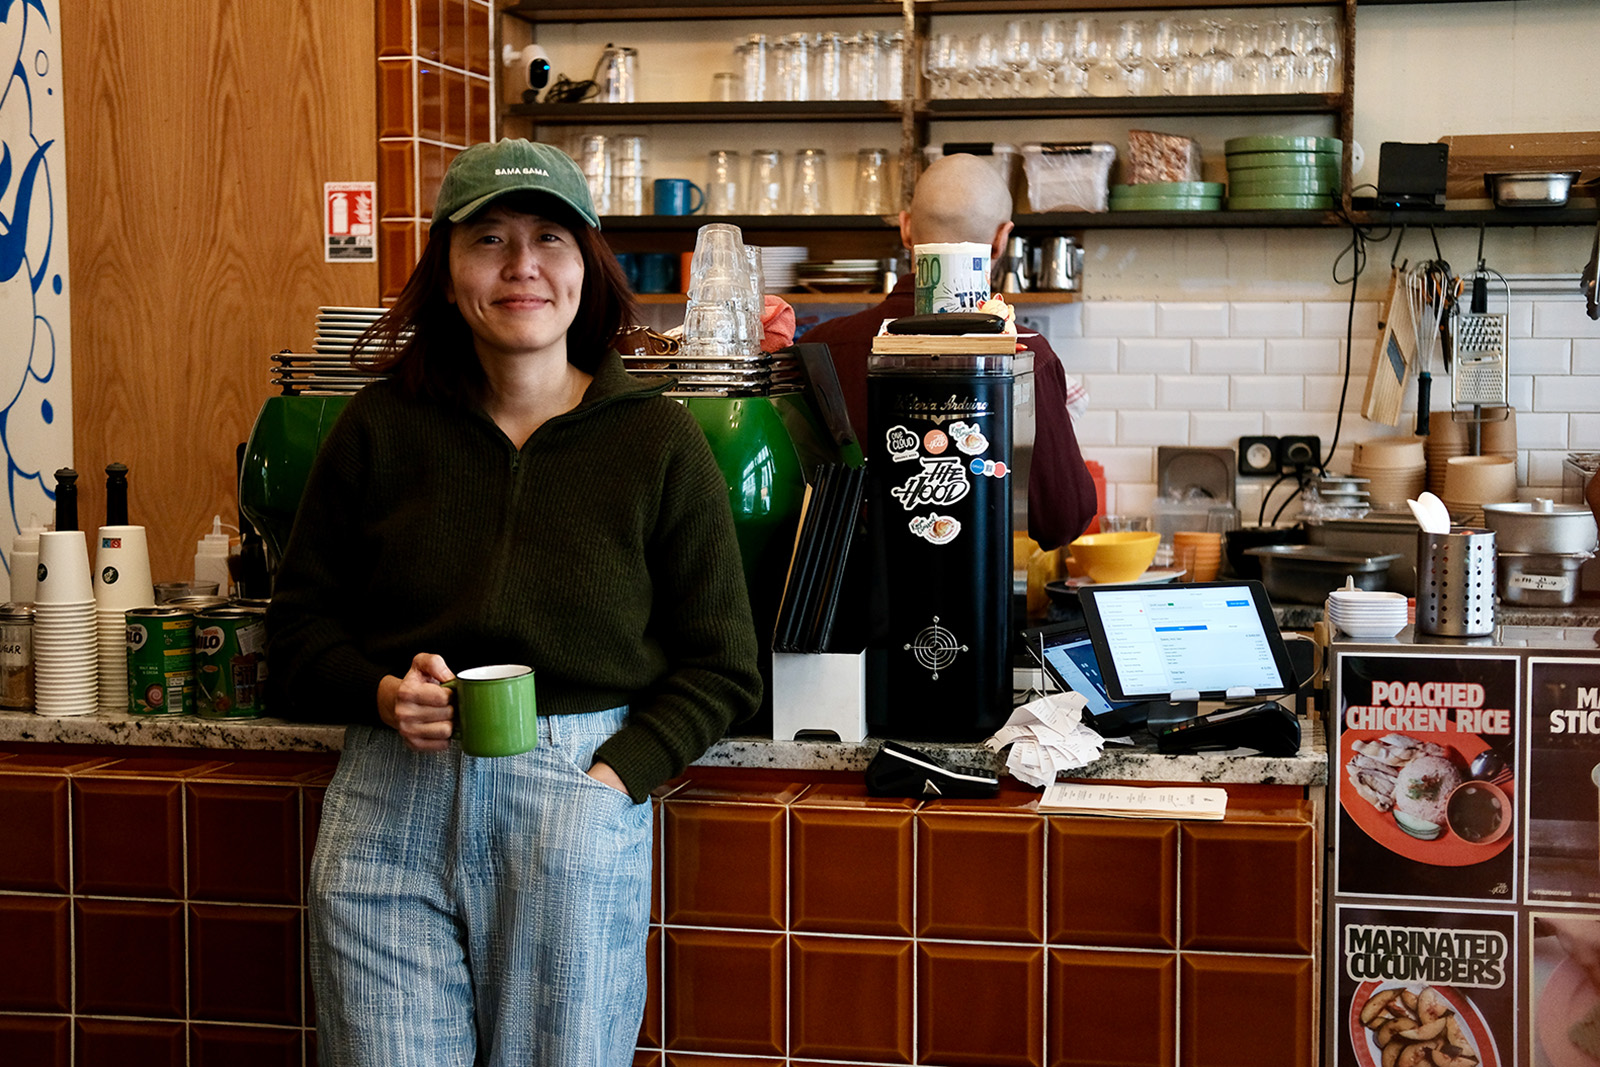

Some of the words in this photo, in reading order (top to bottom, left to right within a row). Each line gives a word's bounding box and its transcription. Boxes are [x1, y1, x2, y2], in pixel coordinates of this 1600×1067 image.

[921, 458, 964, 484] THE
[893, 476, 968, 509] HOOD
[1371, 681, 1485, 708] POACHED
[1577, 687, 1600, 709] M
[1346, 706, 1448, 732] CHICKEN
[1456, 709, 1511, 735] RICE
[1349, 928, 1504, 960] MARINATED
[1350, 953, 1501, 984] CUCUMBERS
